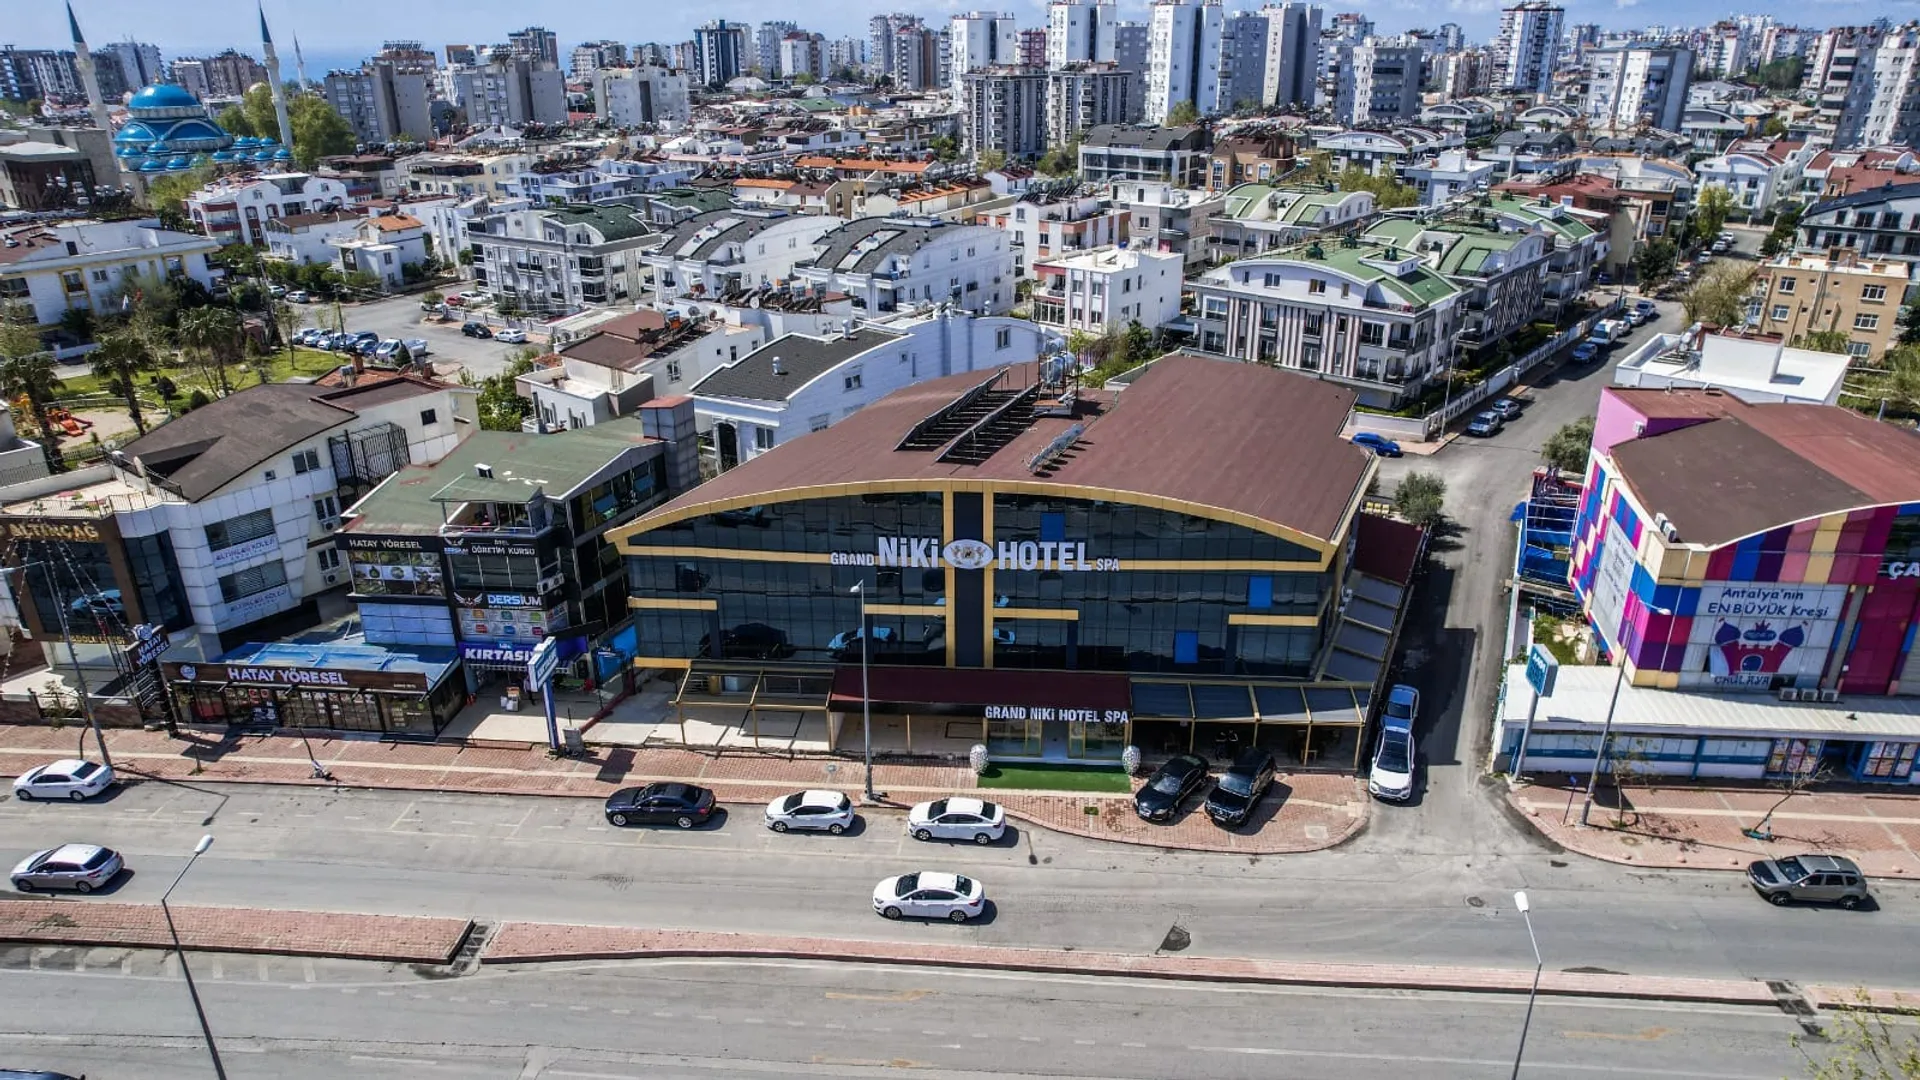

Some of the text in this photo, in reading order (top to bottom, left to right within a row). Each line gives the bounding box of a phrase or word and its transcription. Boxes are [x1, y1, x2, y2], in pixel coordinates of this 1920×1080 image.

[349, 538, 423, 549] HATAY YÖRESEL
[830, 552, 874, 566] GRAND
[998, 541, 1092, 572] HOTEL
[1096, 558, 1120, 572] SPA
[1721, 588, 1804, 601] Antalya'nın
[1707, 602, 1829, 617] EN BÜYÜK Kreşi
[138, 634, 162, 654] HATAY
[228, 668, 348, 685] HATAY YÖRESEL
[985, 705, 1026, 720] GRAND
[1058, 707, 1100, 723] HOTEL
[1104, 709, 1129, 724] SPA
